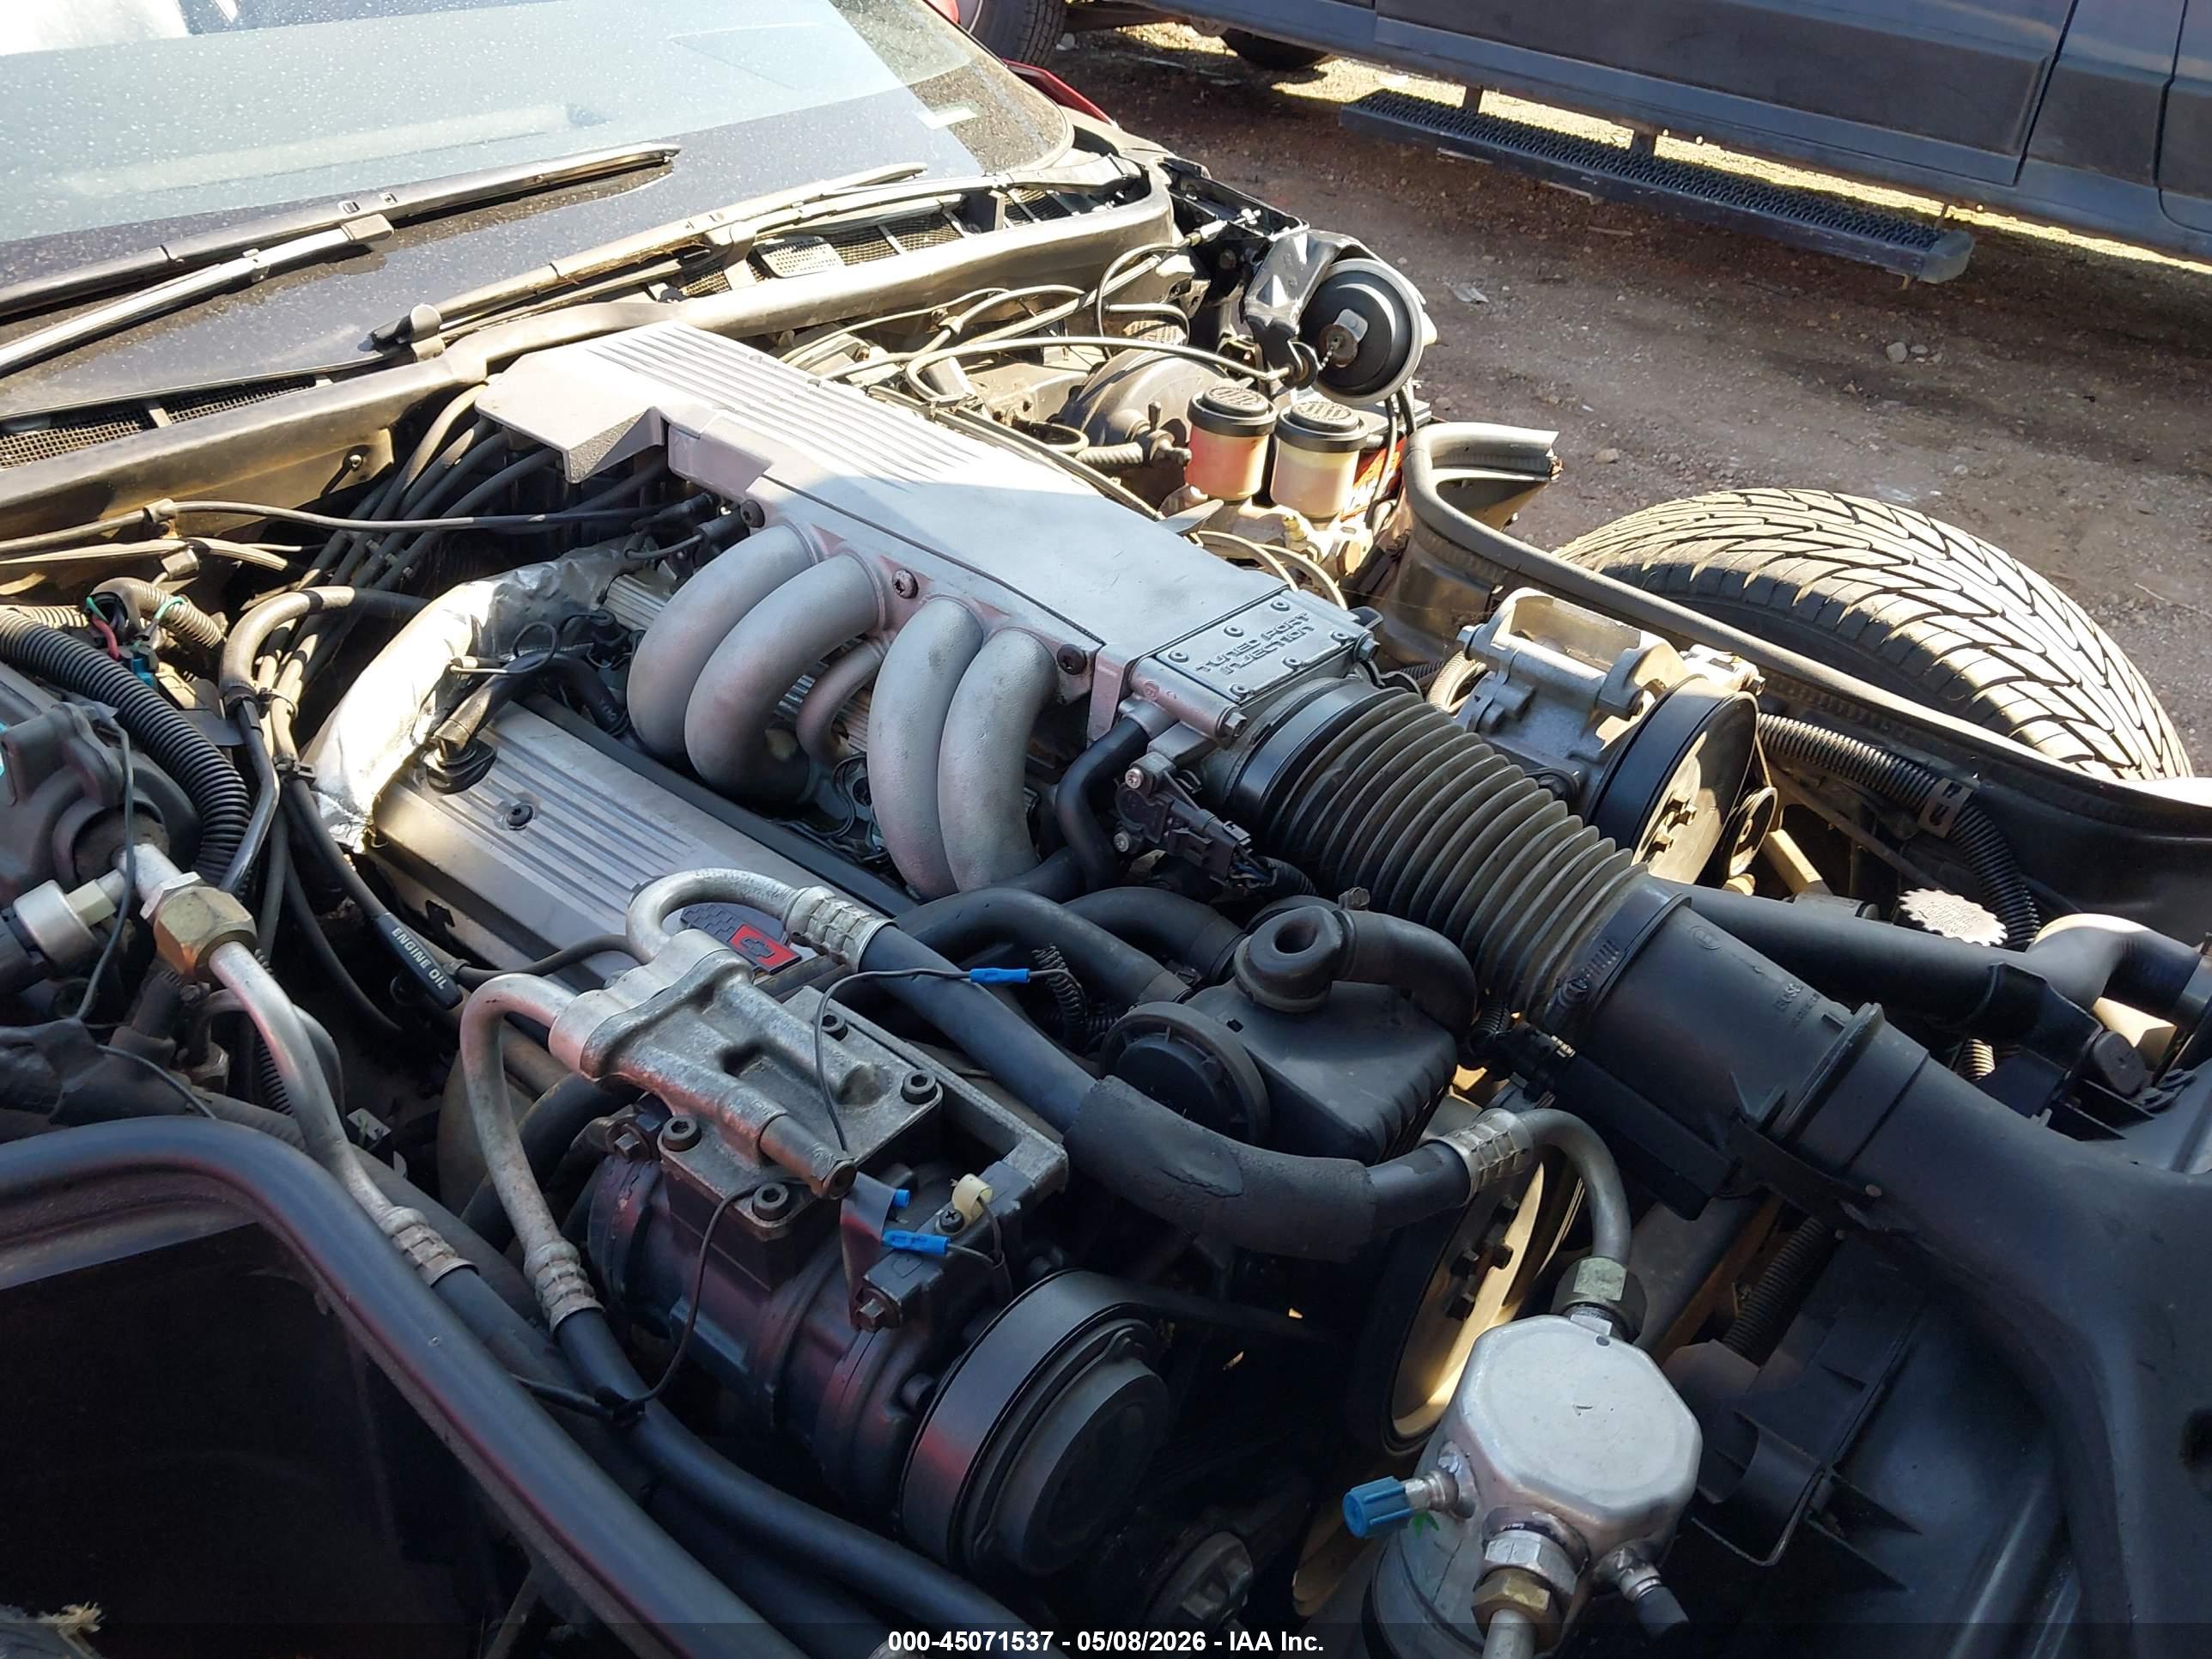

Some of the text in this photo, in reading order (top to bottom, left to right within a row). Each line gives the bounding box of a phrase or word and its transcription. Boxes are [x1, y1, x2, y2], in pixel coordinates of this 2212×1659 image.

[1195, 611, 1308, 672] TUNED PORT
[1219, 626, 1315, 676] INJECTION
[392, 927, 447, 990] ENGINE OIL
